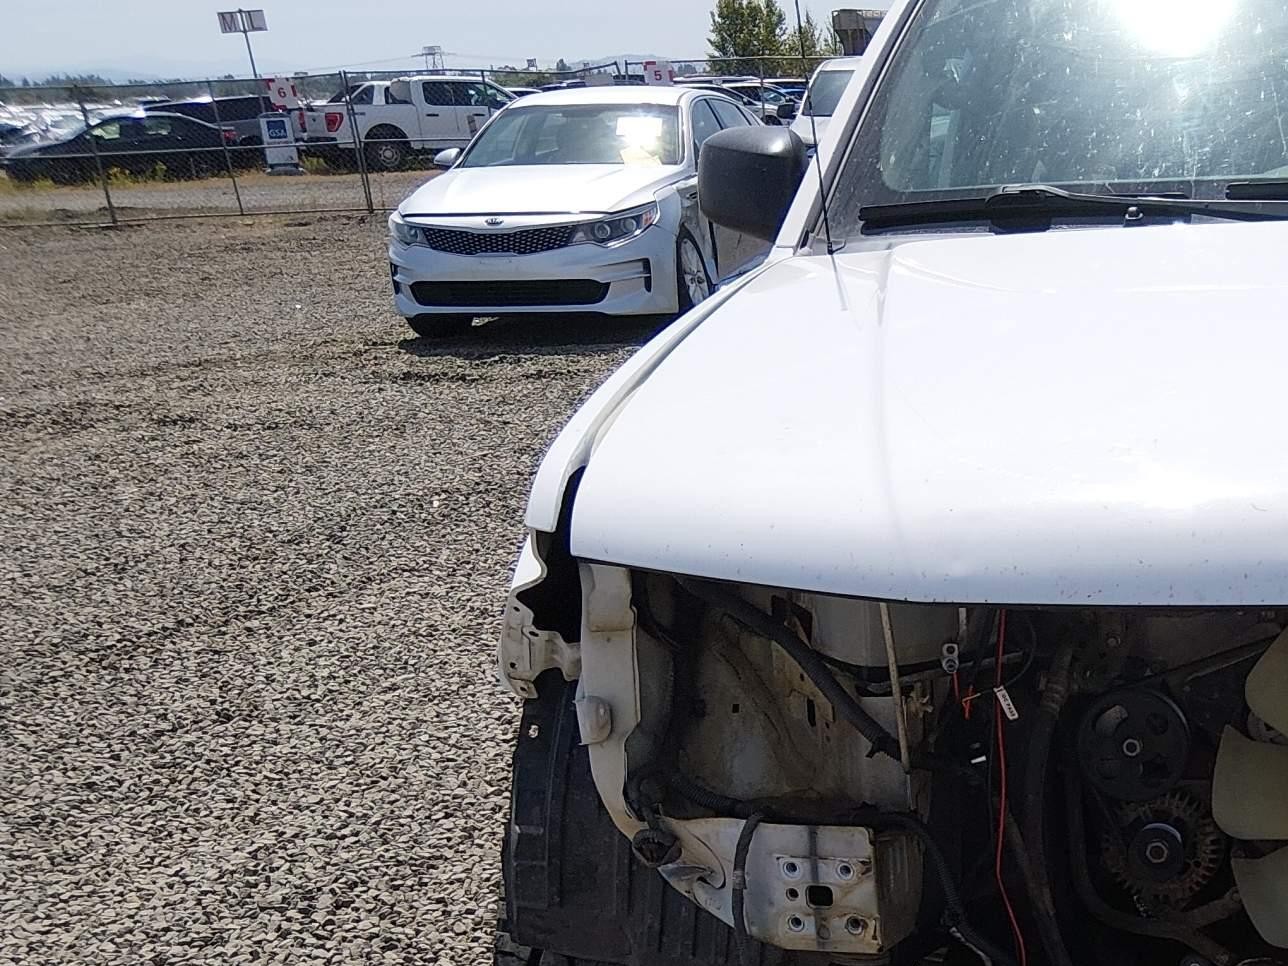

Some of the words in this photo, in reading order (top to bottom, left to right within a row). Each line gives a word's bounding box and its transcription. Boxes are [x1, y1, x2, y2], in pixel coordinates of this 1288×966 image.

[221, 13, 238, 32] M
[654, 70, 663, 81] 5
[277, 87, 286, 98] 6
[268, 128, 287, 138] GSA
